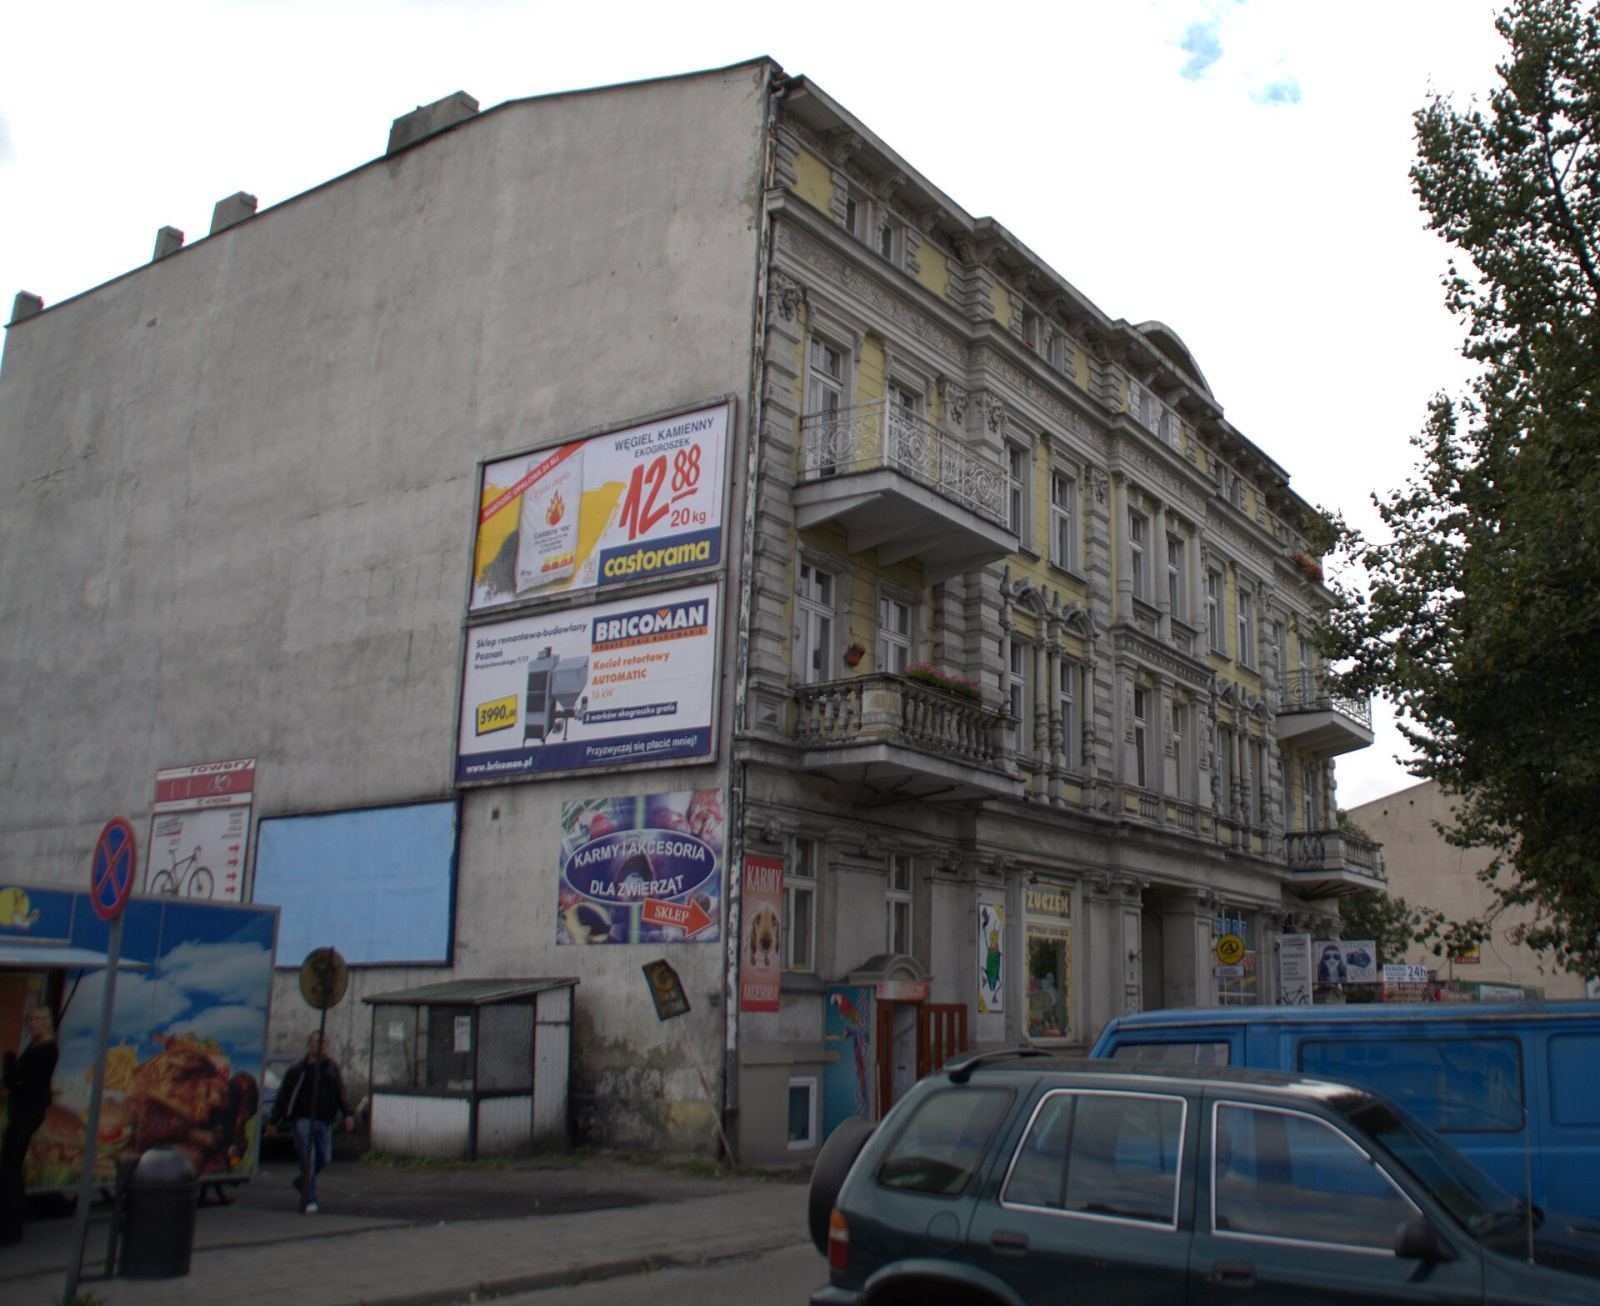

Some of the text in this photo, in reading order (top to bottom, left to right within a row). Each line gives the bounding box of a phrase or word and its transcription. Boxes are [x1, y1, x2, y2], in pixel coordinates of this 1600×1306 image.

[614, 417, 715, 452] WĘGIEL KAMIENNY
[634, 436, 691, 459] EKOGROSZEK
[670, 507, 706, 528] 20 kg
[604, 540, 710, 577] castorama
[595, 604, 705, 642] BRICOMAN
[476, 637, 497, 649] Sklep
[623, 652, 670, 667] retortowy
[591, 668, 648, 686] AUTOMATIC
[656, 703, 676, 714] gratis
[585, 741, 632, 757] Przyzwyczaj
[633, 739, 645, 752] się
[672, 734, 698, 748] mniej!
[465, 756, 533, 773] www.bricoman.pl
[574, 845, 619, 868] KARMY
[629, 840, 706, 862] AKCESORIA
[589, 874, 685, 899] DLA ZWIERZĄT
[746, 863, 783, 895] KARMY
[654, 904, 690, 923] SKLEP
[1408, 965, 1427, 977] 24h
